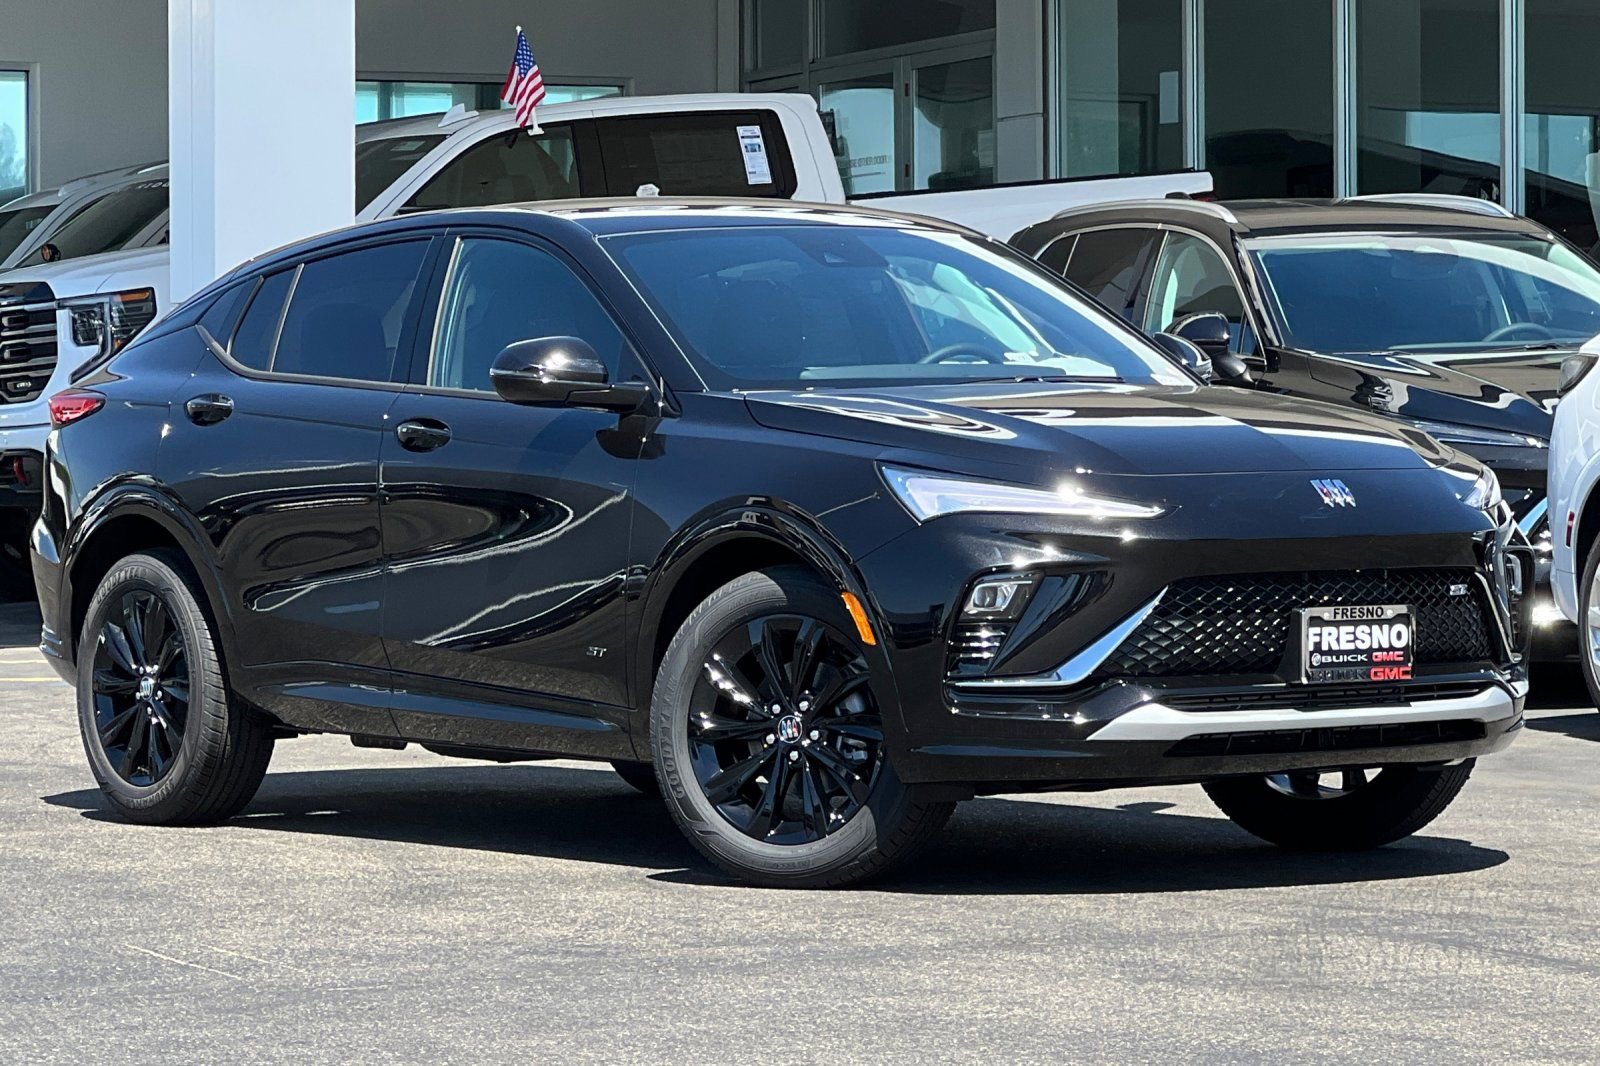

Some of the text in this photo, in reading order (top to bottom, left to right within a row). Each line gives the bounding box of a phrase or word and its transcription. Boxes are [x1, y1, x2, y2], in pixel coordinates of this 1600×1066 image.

[1450, 584, 1468, 596] ST
[1333, 606, 1385, 619] FRESNO
[1308, 623, 1409, 651] FRESNO
[586, 646, 608, 658] ST
[1321, 651, 1404, 663] BUICK GMC
[1370, 666, 1413, 680] GMC
